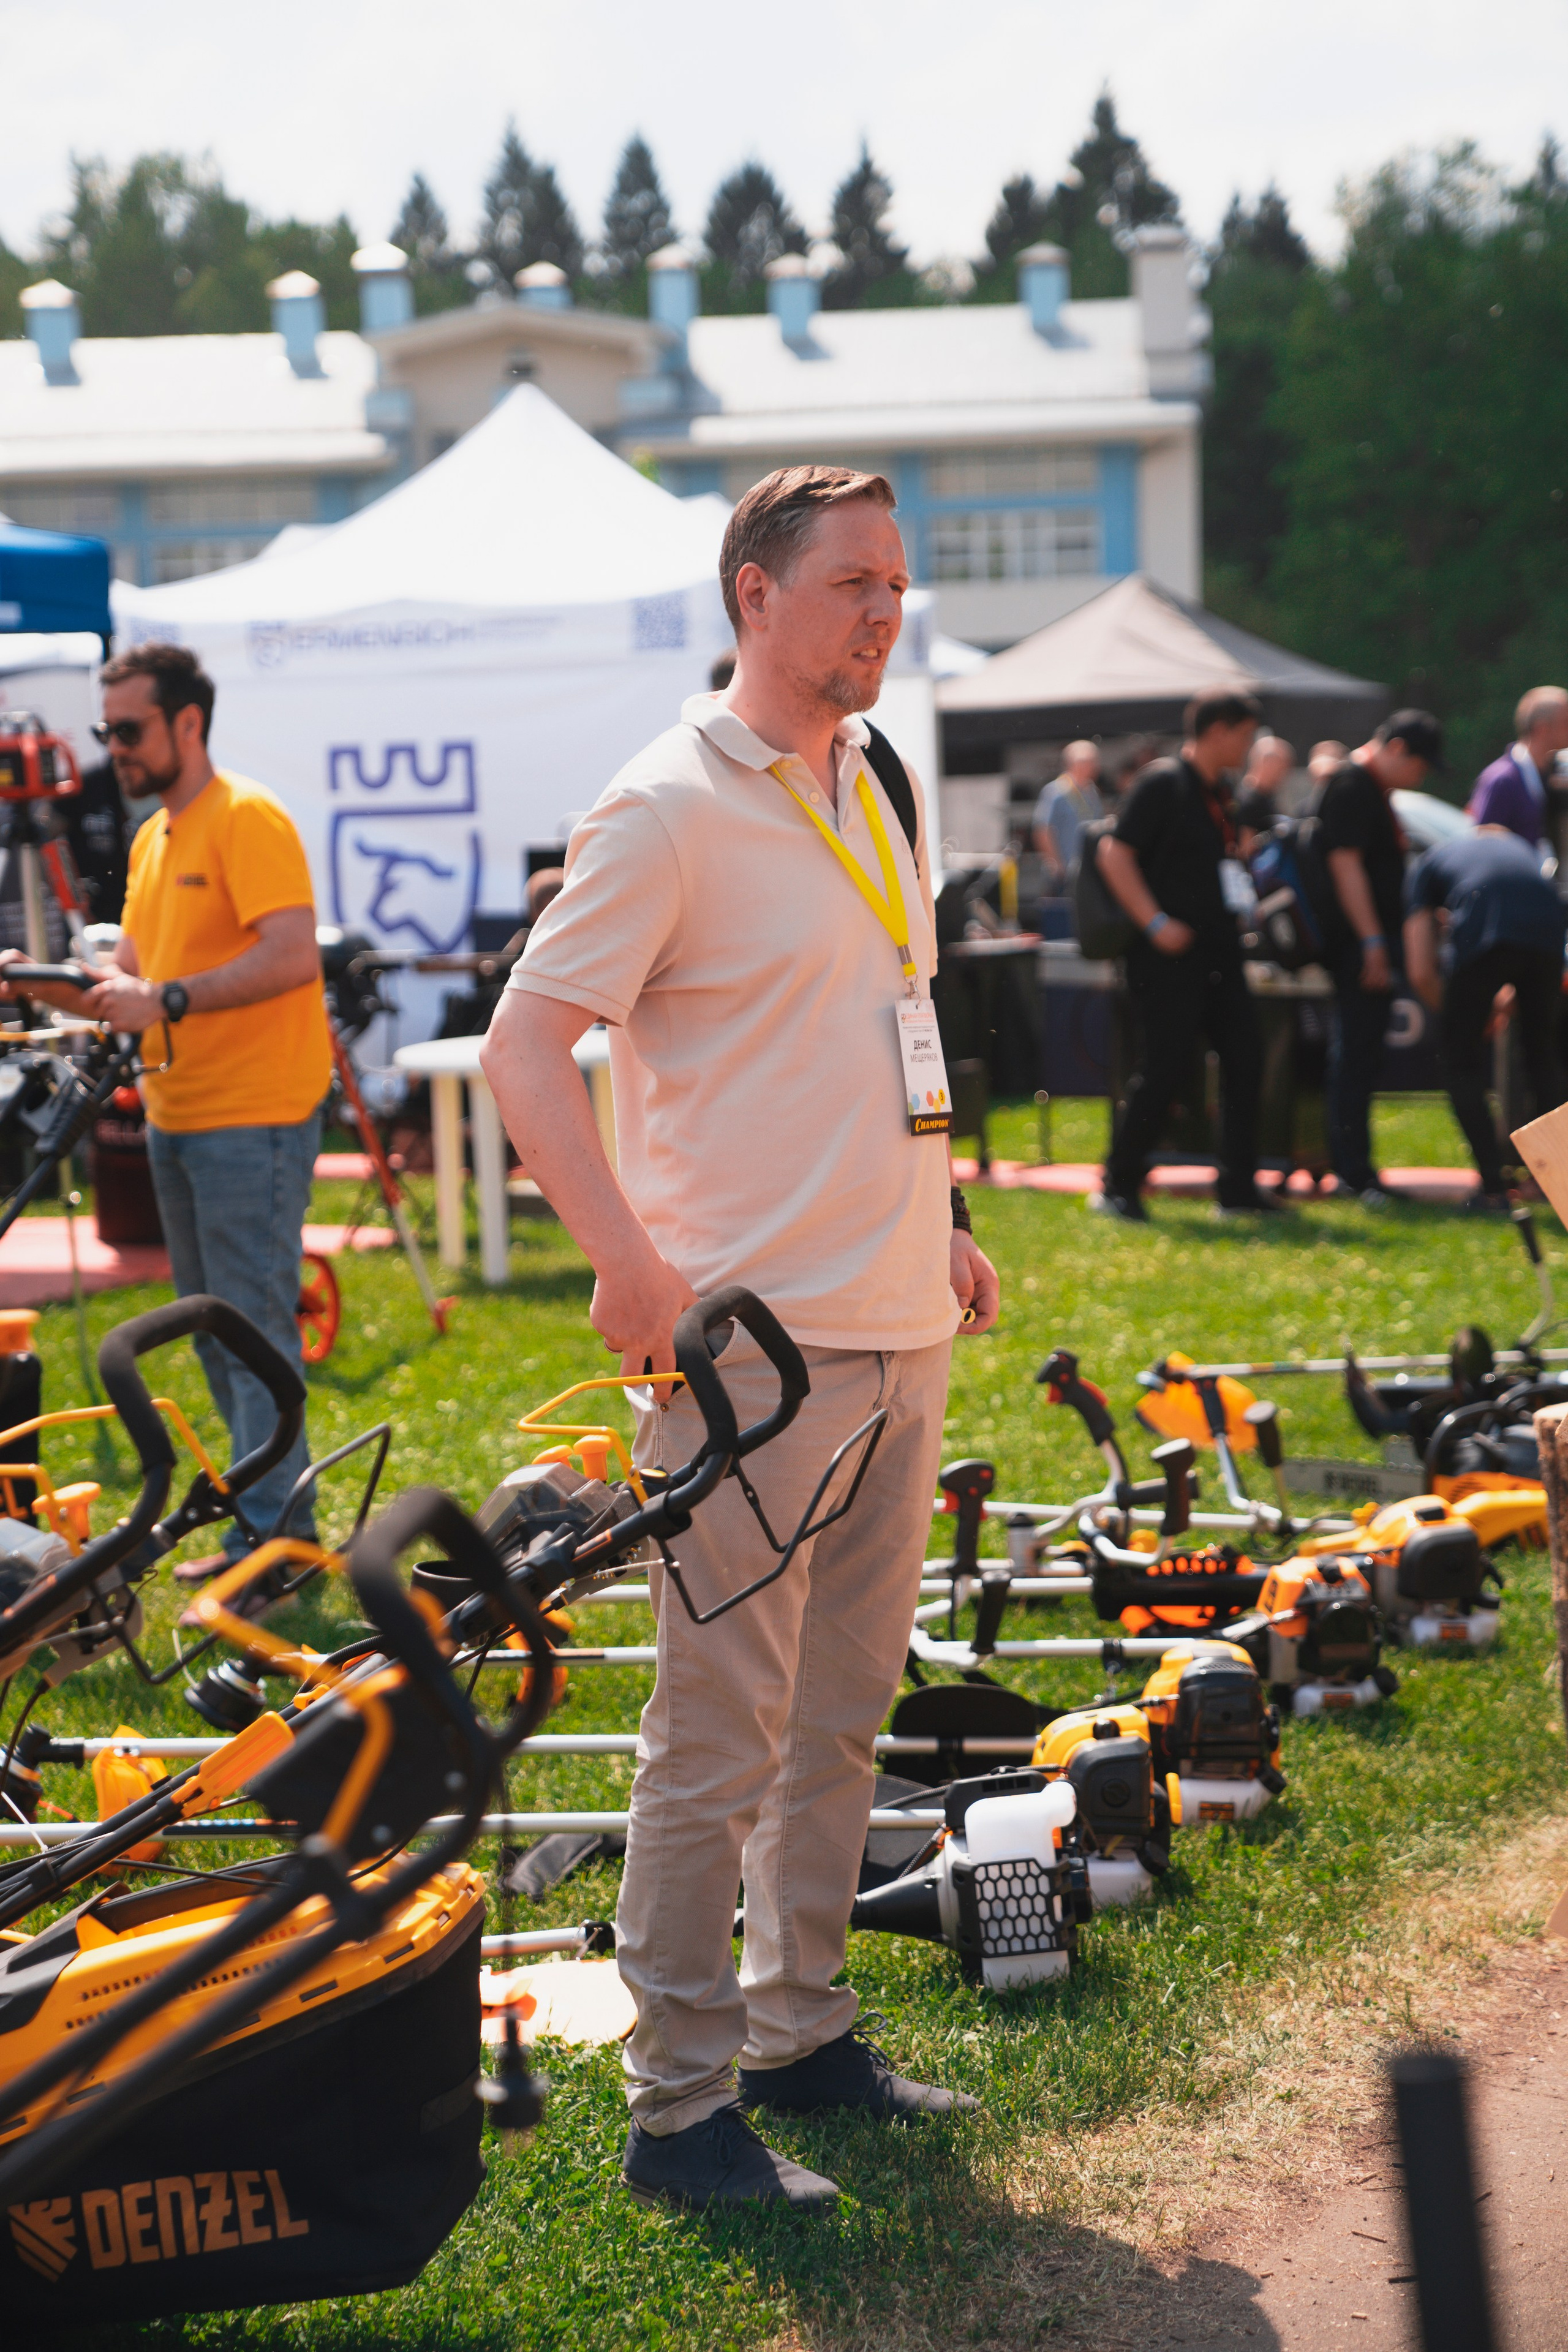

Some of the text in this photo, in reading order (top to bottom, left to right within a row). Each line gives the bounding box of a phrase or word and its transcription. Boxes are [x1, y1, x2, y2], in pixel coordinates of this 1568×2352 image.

[914, 1039, 932, 1051] ДЕНИС
[910, 1053, 938, 1063] МЕЩЕРЯКОВ
[940, 1092, 944, 1101] 3
[81, 2169, 309, 2270] DENZEL
